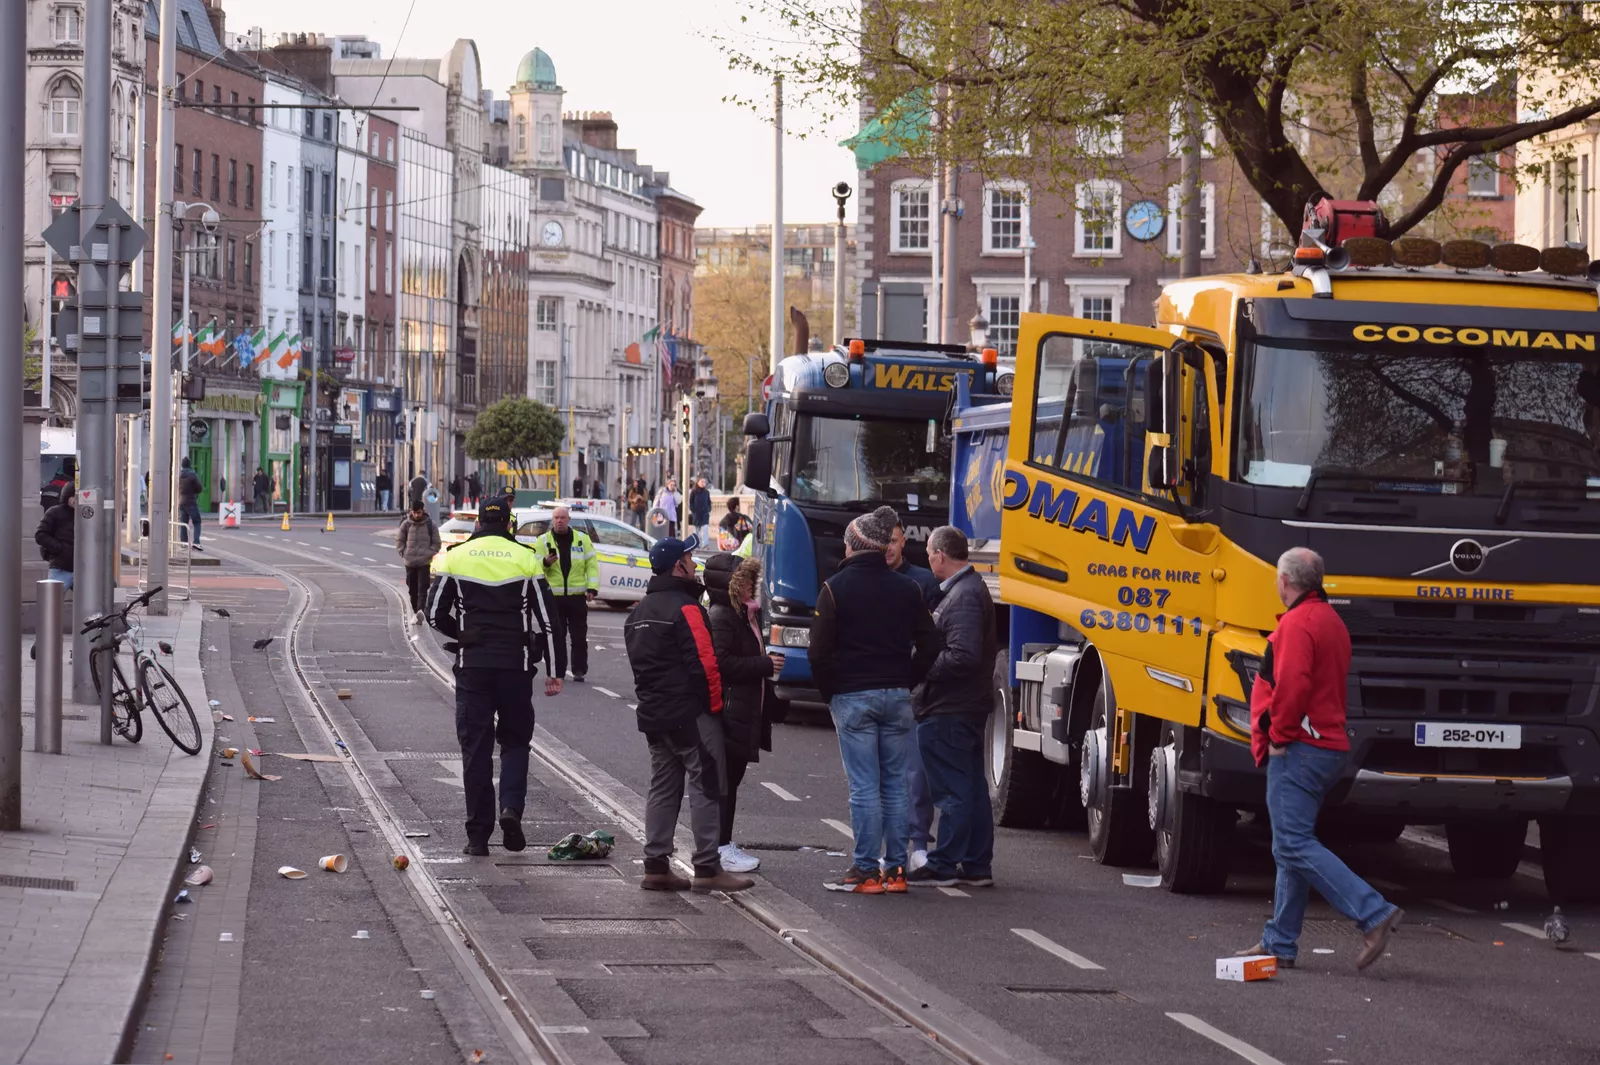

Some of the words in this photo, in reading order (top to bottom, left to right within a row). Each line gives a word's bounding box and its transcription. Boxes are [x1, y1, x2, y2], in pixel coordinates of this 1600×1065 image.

[1352, 324, 1596, 351] COCOMAN
[468, 549, 512, 559] GARDA
[610, 575, 649, 589] GARDA
[1087, 562, 1128, 578] GRAB
[1132, 567, 1161, 581] FOR
[1165, 569, 1201, 585] HIRE
[1117, 586, 1171, 608] 087
[1416, 585, 1467, 599] GRAB
[1472, 587, 1515, 601] HIRE
[1080, 608, 1203, 637] 6380111
